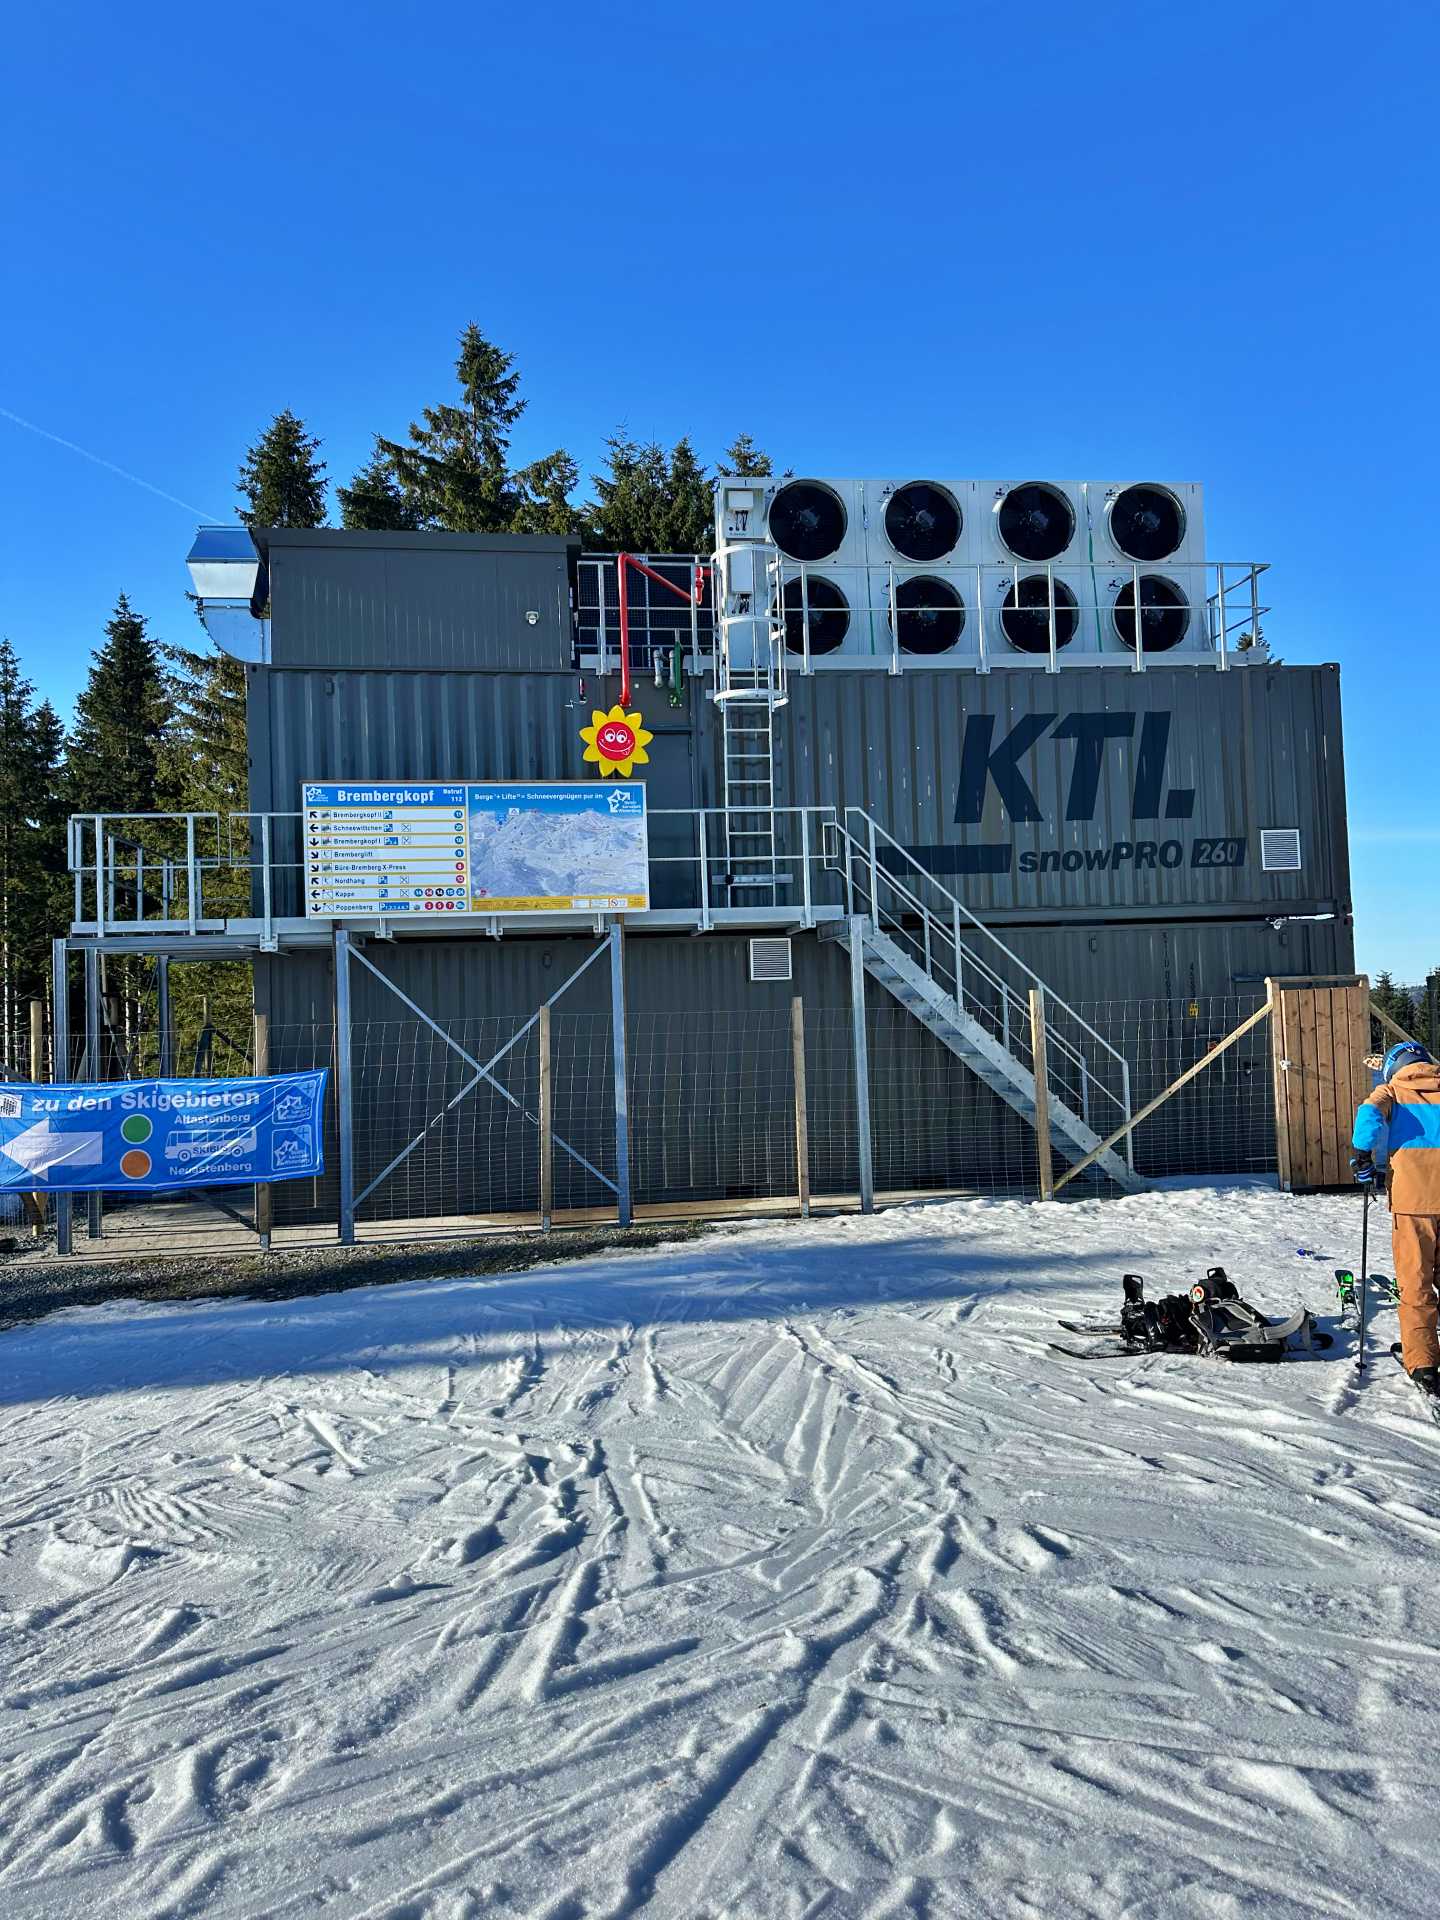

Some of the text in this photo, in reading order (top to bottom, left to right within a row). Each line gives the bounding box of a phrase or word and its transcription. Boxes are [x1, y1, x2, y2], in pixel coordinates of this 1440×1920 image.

[337, 790, 434, 804] Brembergkopf
[526, 792, 582, 800] Schneevergnügen
[1018, 840, 1241, 873] snowPRO 260
[32, 1090, 260, 1112] zu den Skigebieten
[174, 1114, 250, 1124] Altastenberg
[170, 1162, 252, 1175] Neuastenberg
